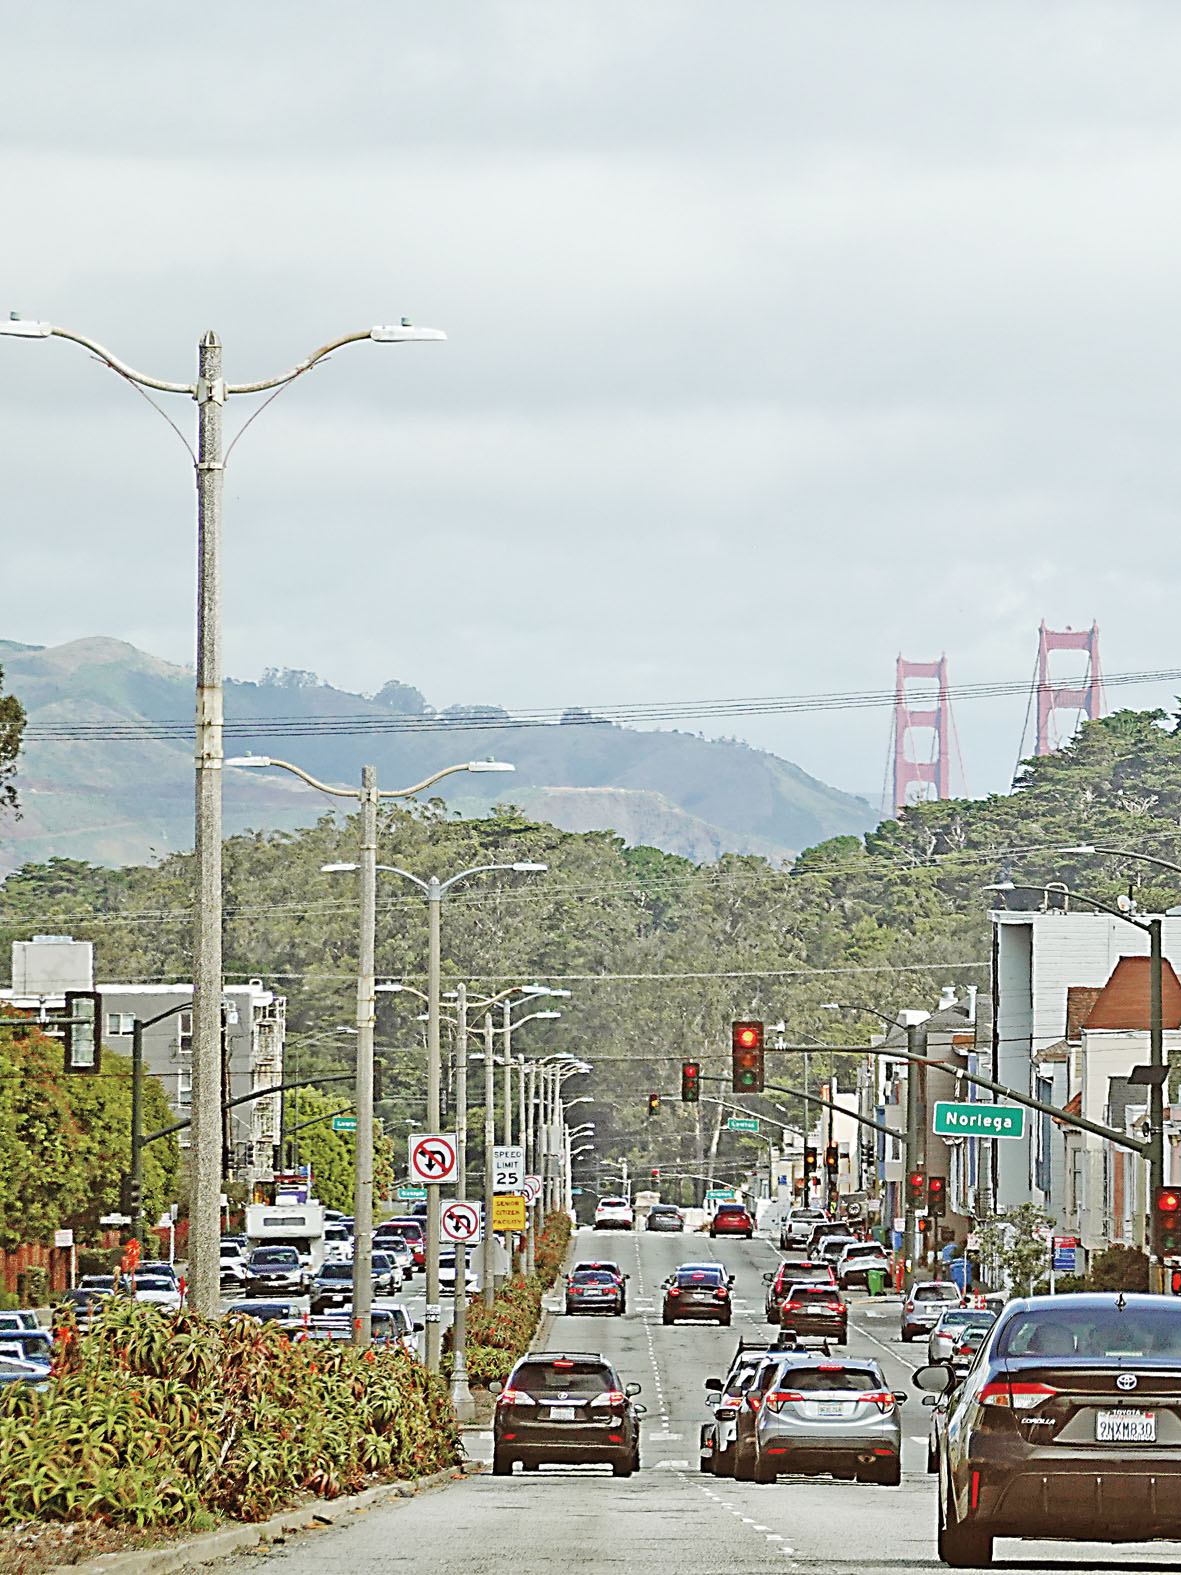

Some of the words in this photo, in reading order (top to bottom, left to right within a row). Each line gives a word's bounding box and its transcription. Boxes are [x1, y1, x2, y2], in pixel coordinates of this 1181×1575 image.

[946, 1112, 1012, 1132] Noriega
[494, 1151, 522, 1159] SPEED
[496, 1161, 518, 1169] LIMIT
[496, 1172, 519, 1185] 25
[1100, 1421, 1153, 1438] 9NXM830
